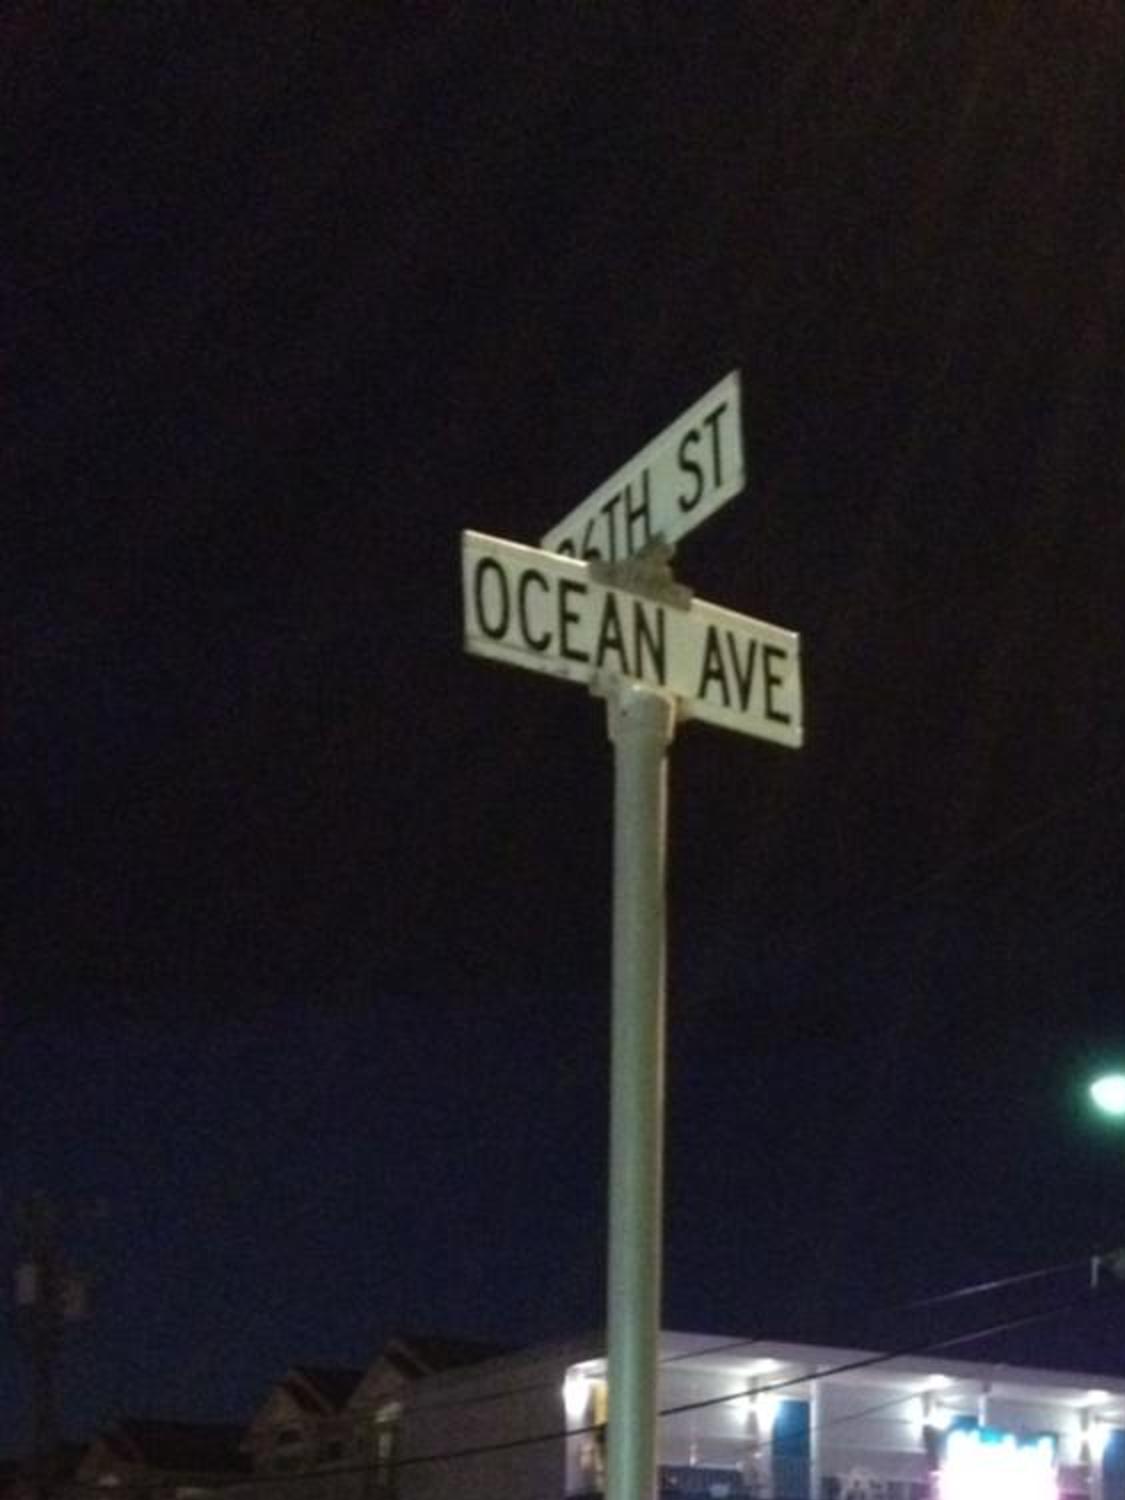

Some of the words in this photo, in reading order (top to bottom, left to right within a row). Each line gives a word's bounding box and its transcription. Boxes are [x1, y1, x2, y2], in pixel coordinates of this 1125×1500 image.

[556, 467, 651, 563] 6TH
[676, 403, 728, 514] ST
[473, 556, 667, 687] OCEAN
[697, 625, 792, 725] AVE
